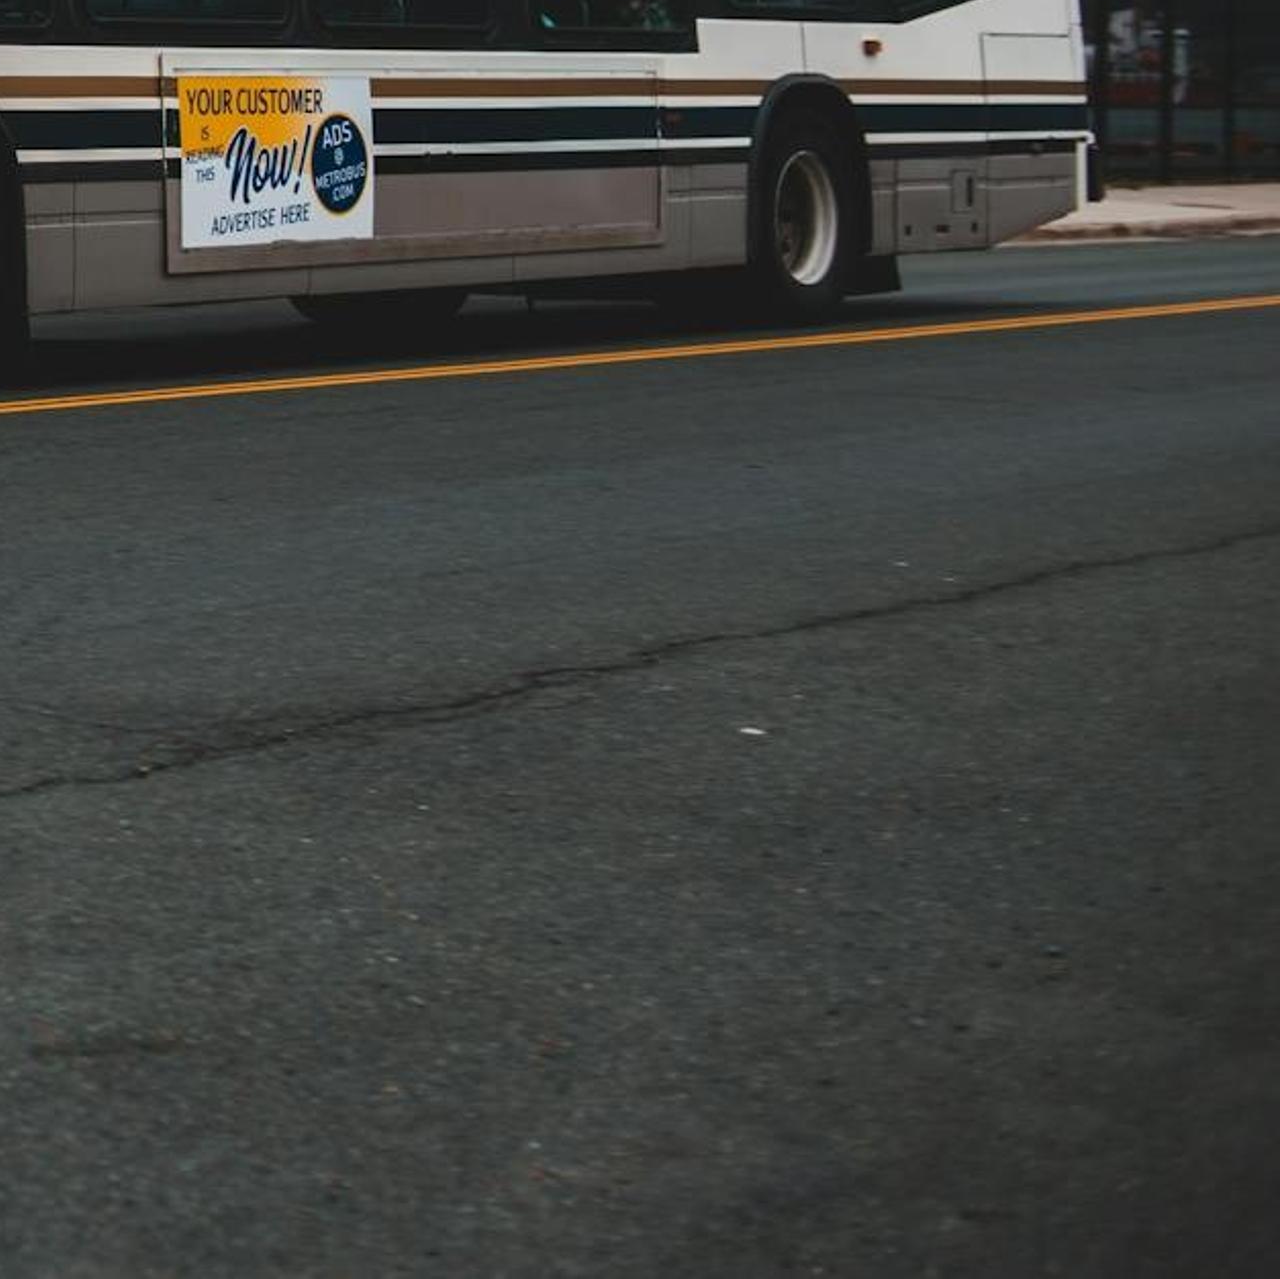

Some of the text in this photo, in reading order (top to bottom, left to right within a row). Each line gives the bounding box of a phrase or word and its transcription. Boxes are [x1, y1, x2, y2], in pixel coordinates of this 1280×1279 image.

[186, 87, 323, 116] YOUR CUSTOMER
[322, 121, 353, 150] ADS
[226, 124, 311, 204] Now!
[315, 161, 366, 189] METROBUS
[211, 202, 311, 236] ADVERTISE HERE
